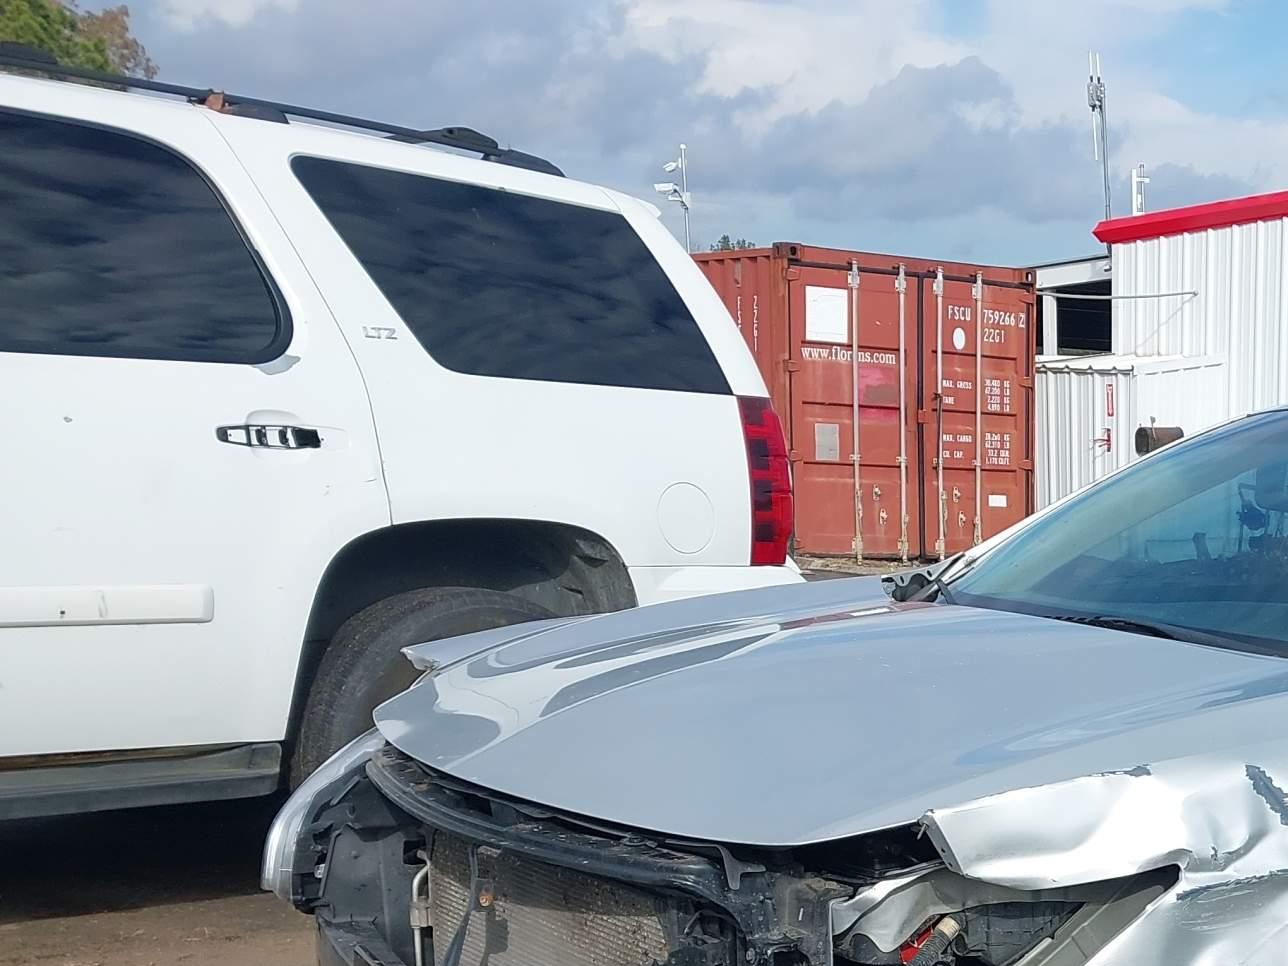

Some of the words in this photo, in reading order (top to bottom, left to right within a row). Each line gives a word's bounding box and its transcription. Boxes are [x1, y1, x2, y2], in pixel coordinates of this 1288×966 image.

[948, 305, 971, 321] FSCU
[983, 309, 1015, 327] 759266
[362, 326, 398, 340] LTZ
[983, 328, 1004, 343] 22G1
[801, 346, 896, 364] www.florns.com
